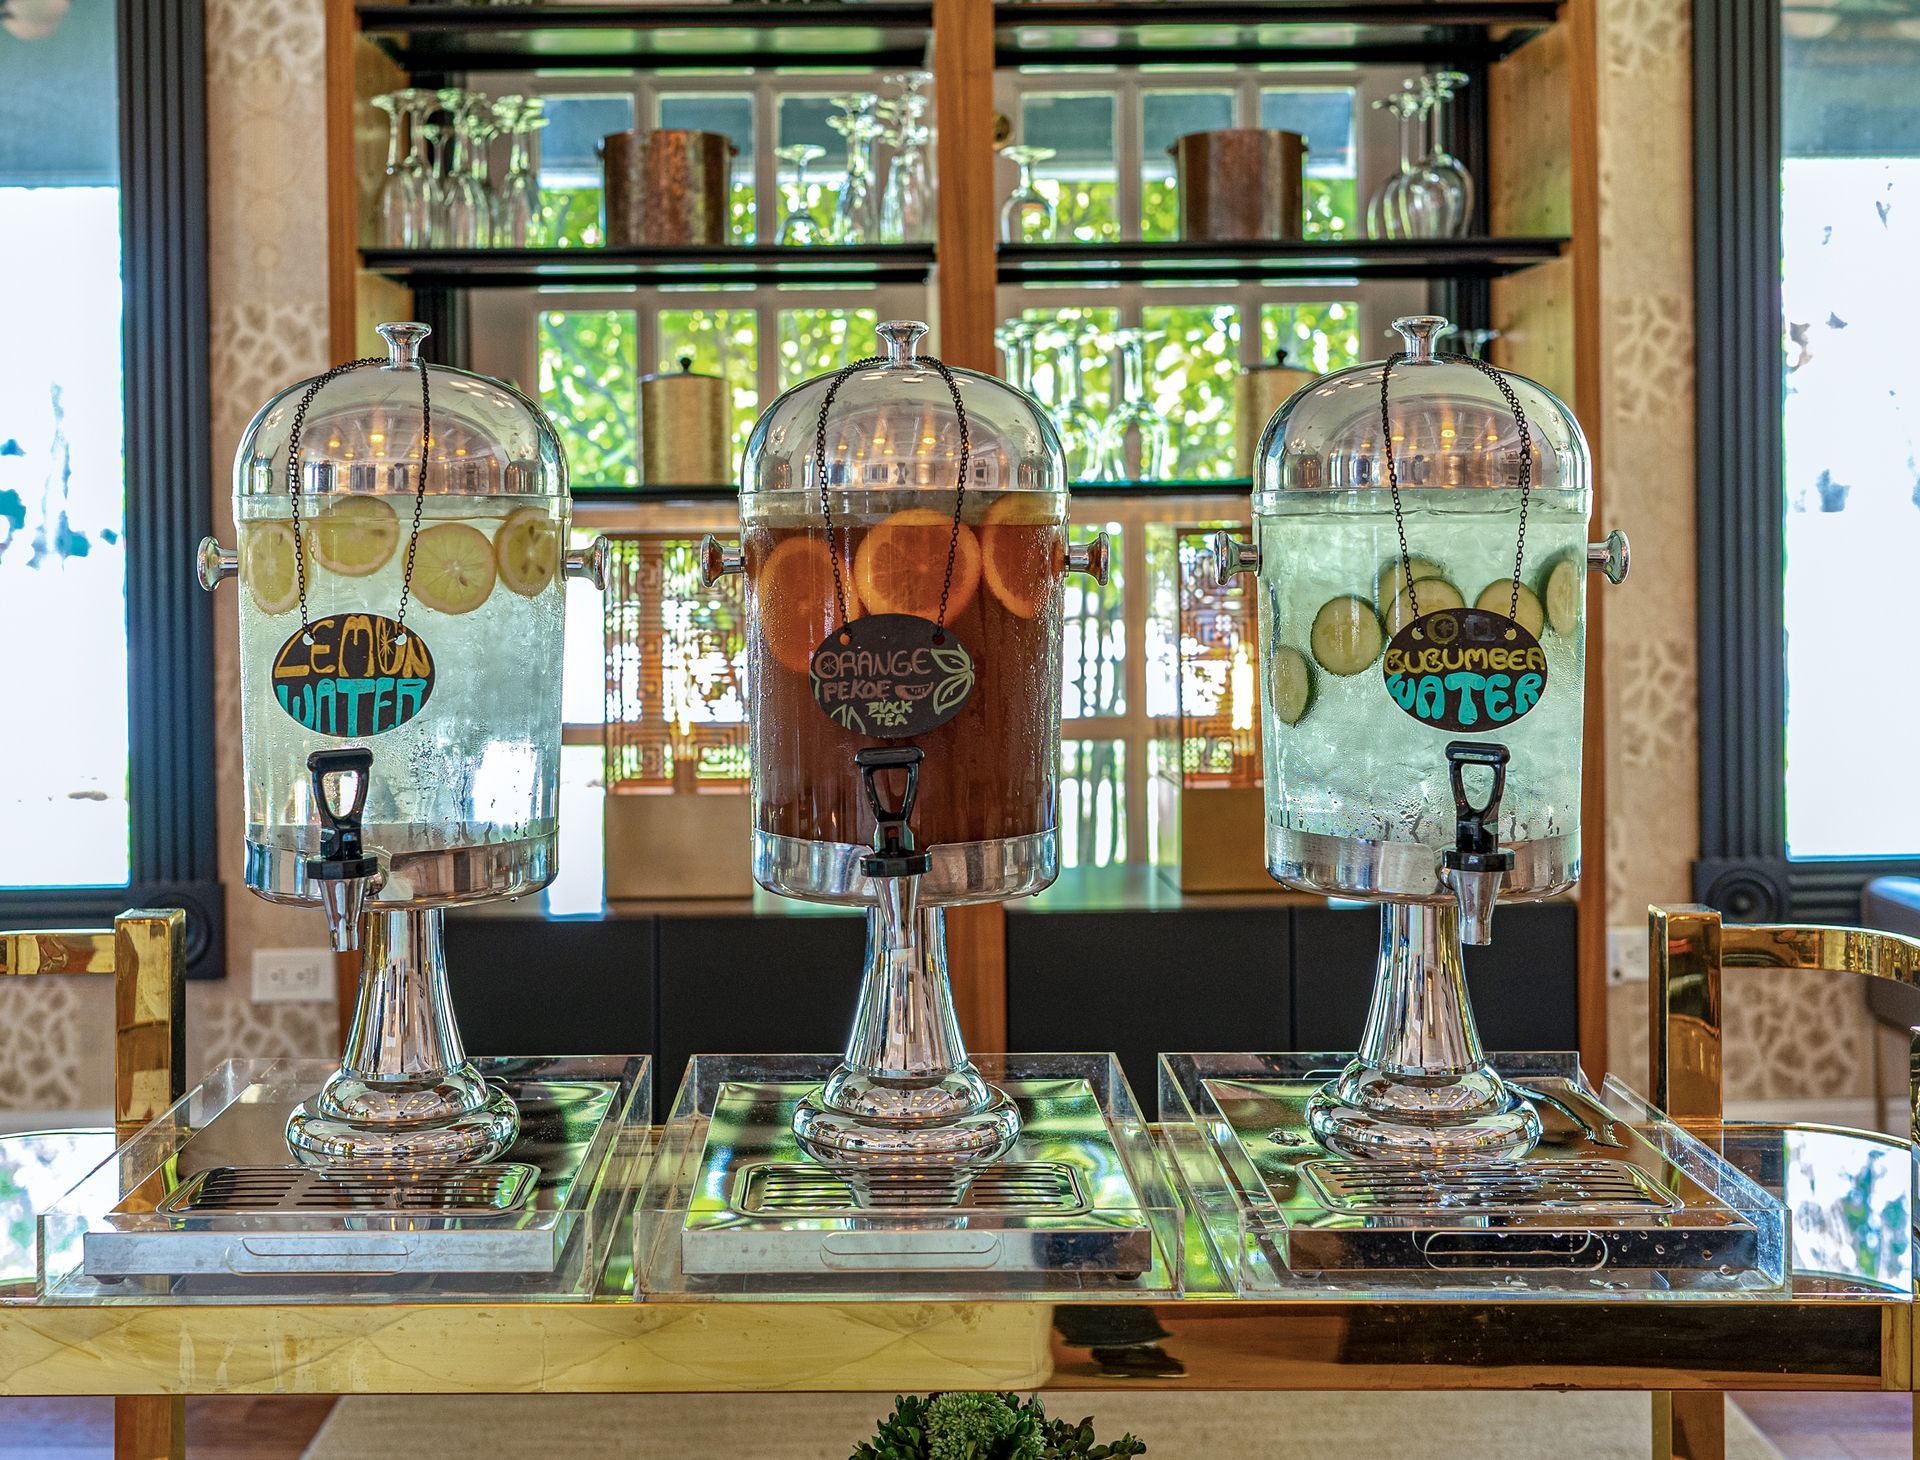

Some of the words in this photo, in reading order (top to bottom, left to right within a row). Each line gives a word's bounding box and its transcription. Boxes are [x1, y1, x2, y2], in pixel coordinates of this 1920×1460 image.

[275, 615, 431, 678] LEMON
[815, 648, 932, 679] ORANGE
[1384, 648, 1546, 675] CUCUMBER
[822, 680, 892, 703] PEKOE
[1386, 672, 1543, 725] WATER
[277, 677, 427, 737] WATER
[865, 701, 913, 715] BLACK
[871, 713, 908, 727] TEA
